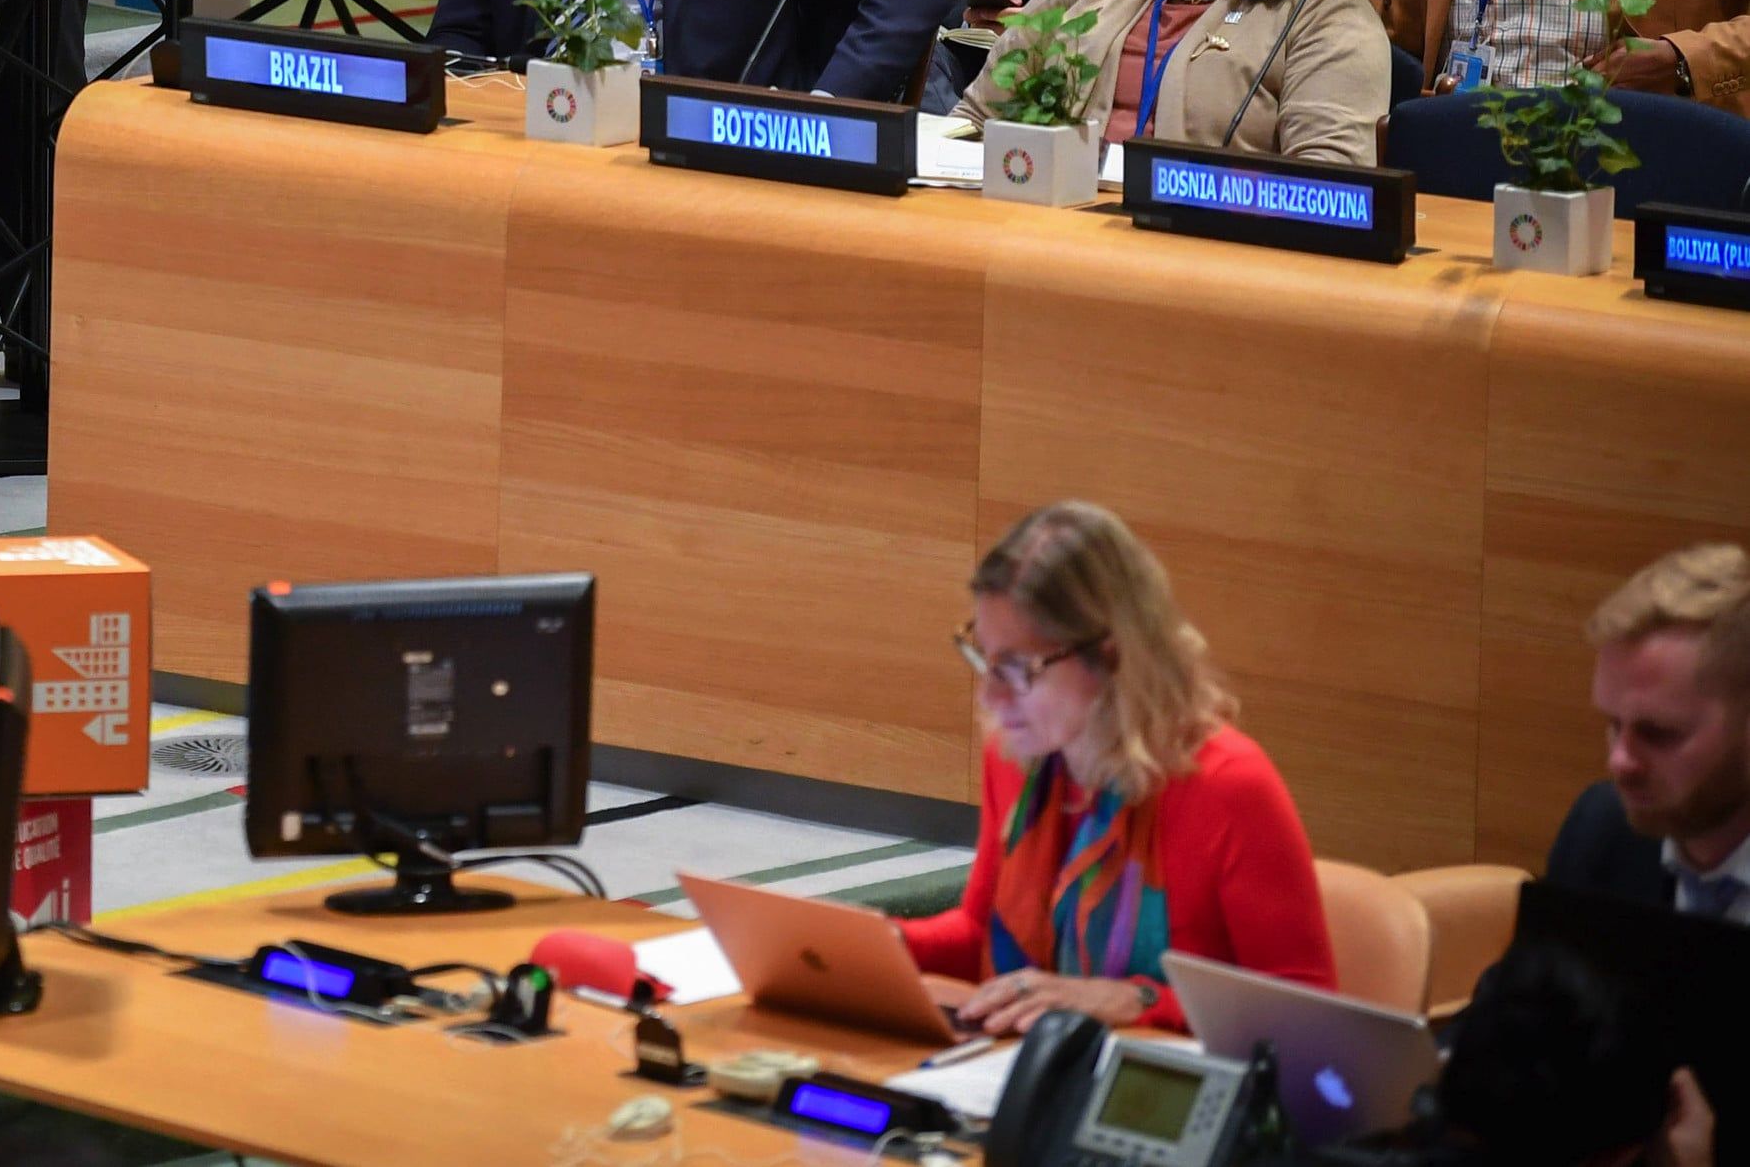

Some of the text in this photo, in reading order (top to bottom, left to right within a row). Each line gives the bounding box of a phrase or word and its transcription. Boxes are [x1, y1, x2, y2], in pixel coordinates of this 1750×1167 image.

[269, 50, 343, 93] BRAZIL
[712, 106, 831, 157] BOTSWANA
[1157, 167, 1368, 221] BOSNIA AND HERZEGOVINA
[1668, 236, 1720, 264] BOLIVIA
